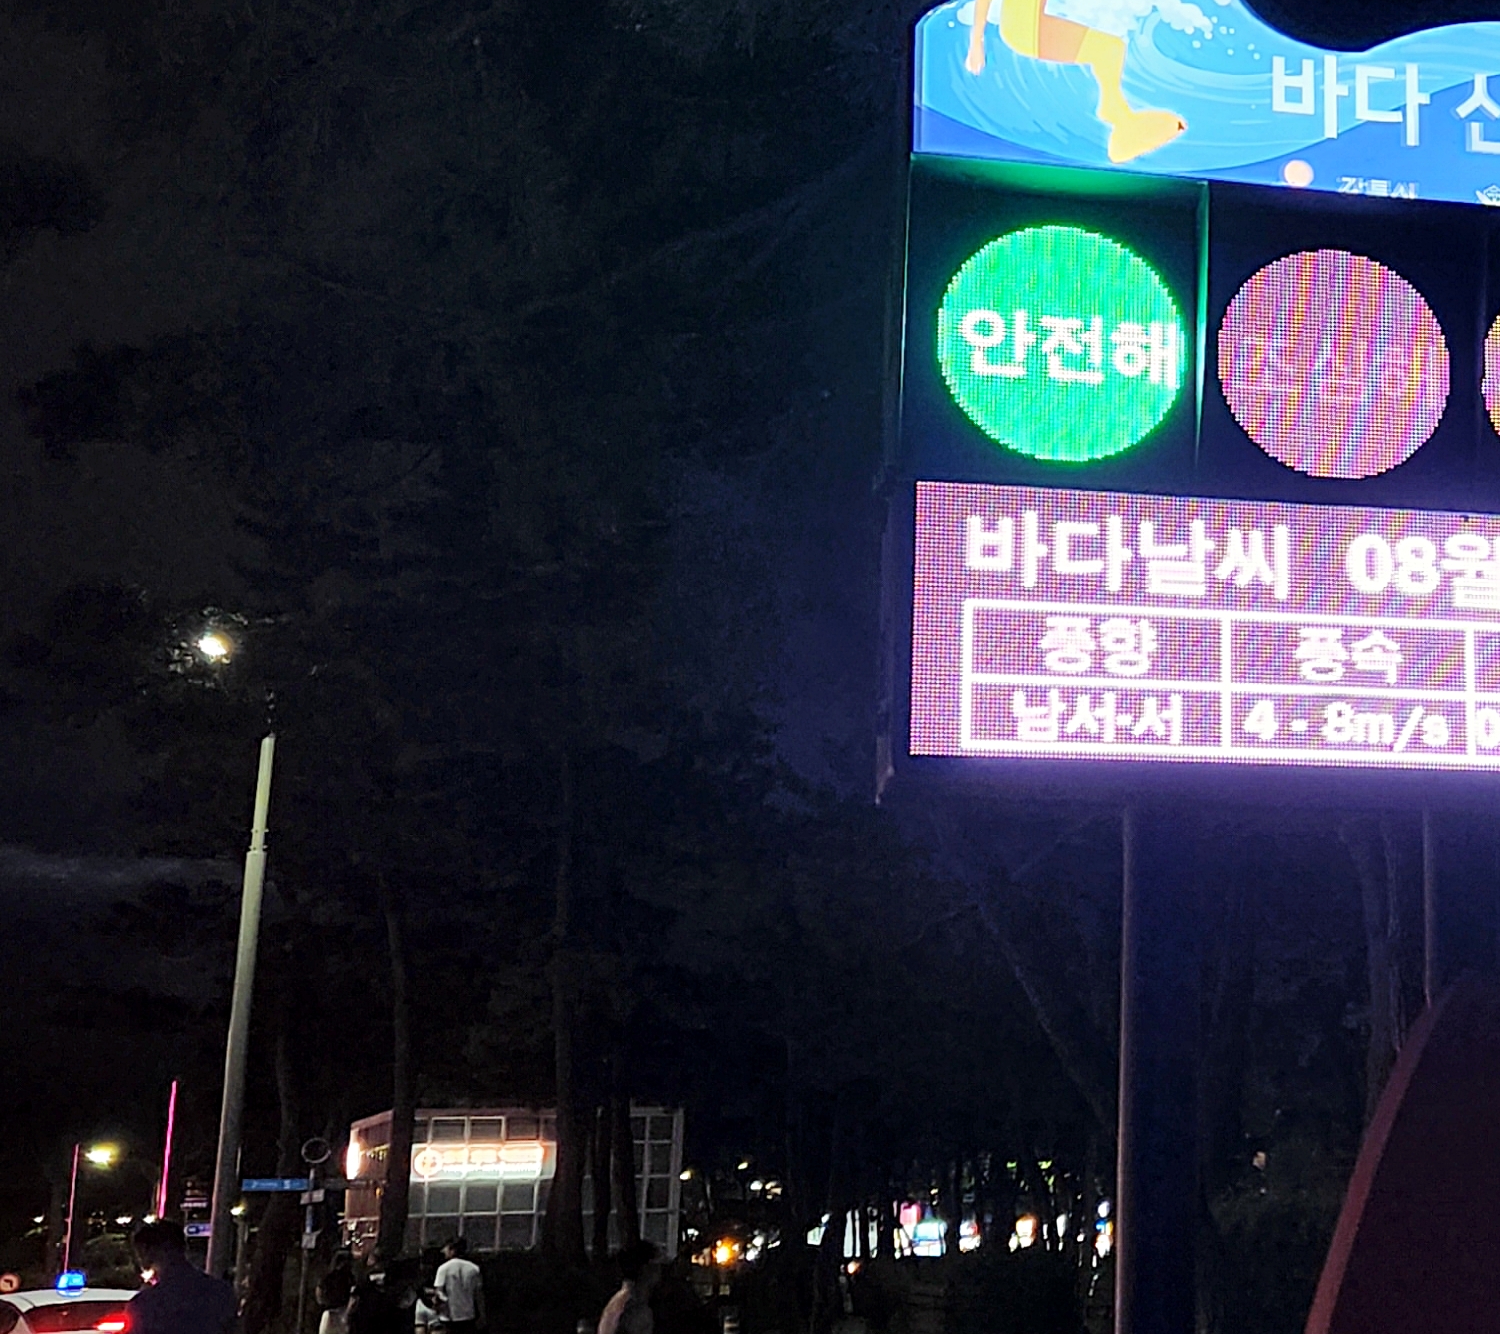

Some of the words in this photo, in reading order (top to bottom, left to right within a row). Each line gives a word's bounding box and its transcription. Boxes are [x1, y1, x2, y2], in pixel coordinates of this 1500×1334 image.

[1272, 54, 1429, 147] 바다
[958, 308, 1178, 389] 안전해
[964, 510, 1290, 600] 바다날씨
[1039, 614, 1158, 674] 풍향
[1293, 626, 1401, 684] 풍속
